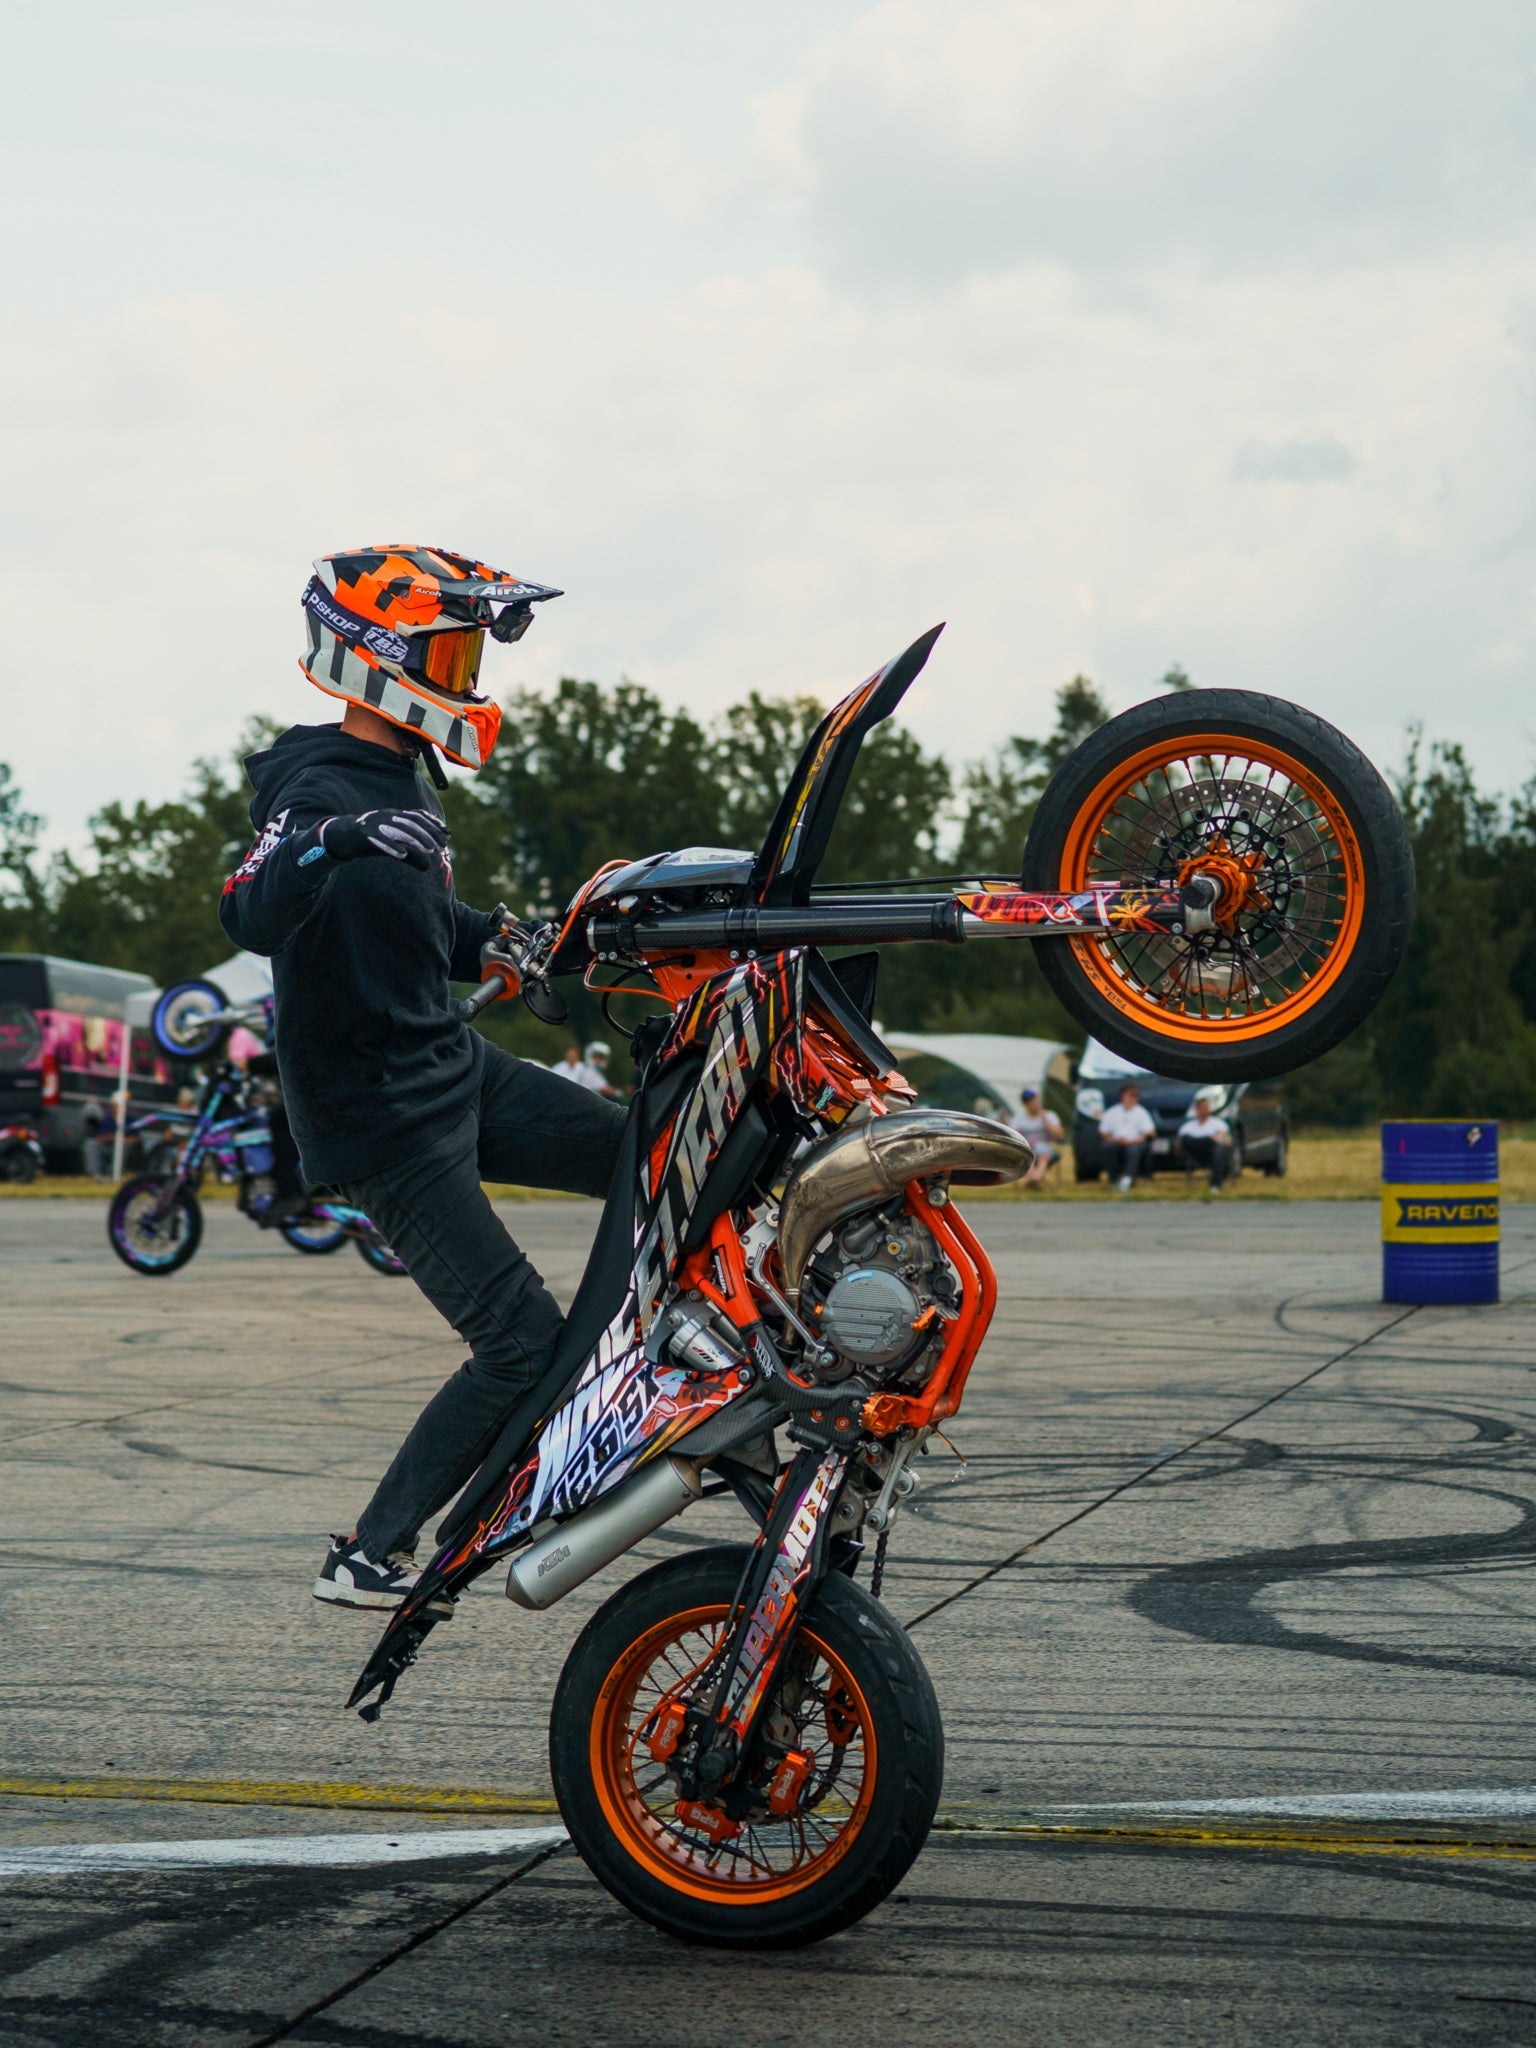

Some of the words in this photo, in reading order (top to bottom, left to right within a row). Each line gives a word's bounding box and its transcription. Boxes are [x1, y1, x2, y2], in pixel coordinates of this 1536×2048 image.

[414, 587, 442, 598] Airoh
[480, 584, 539, 596] Airoh
[537, 1544, 571, 1577] KTM
